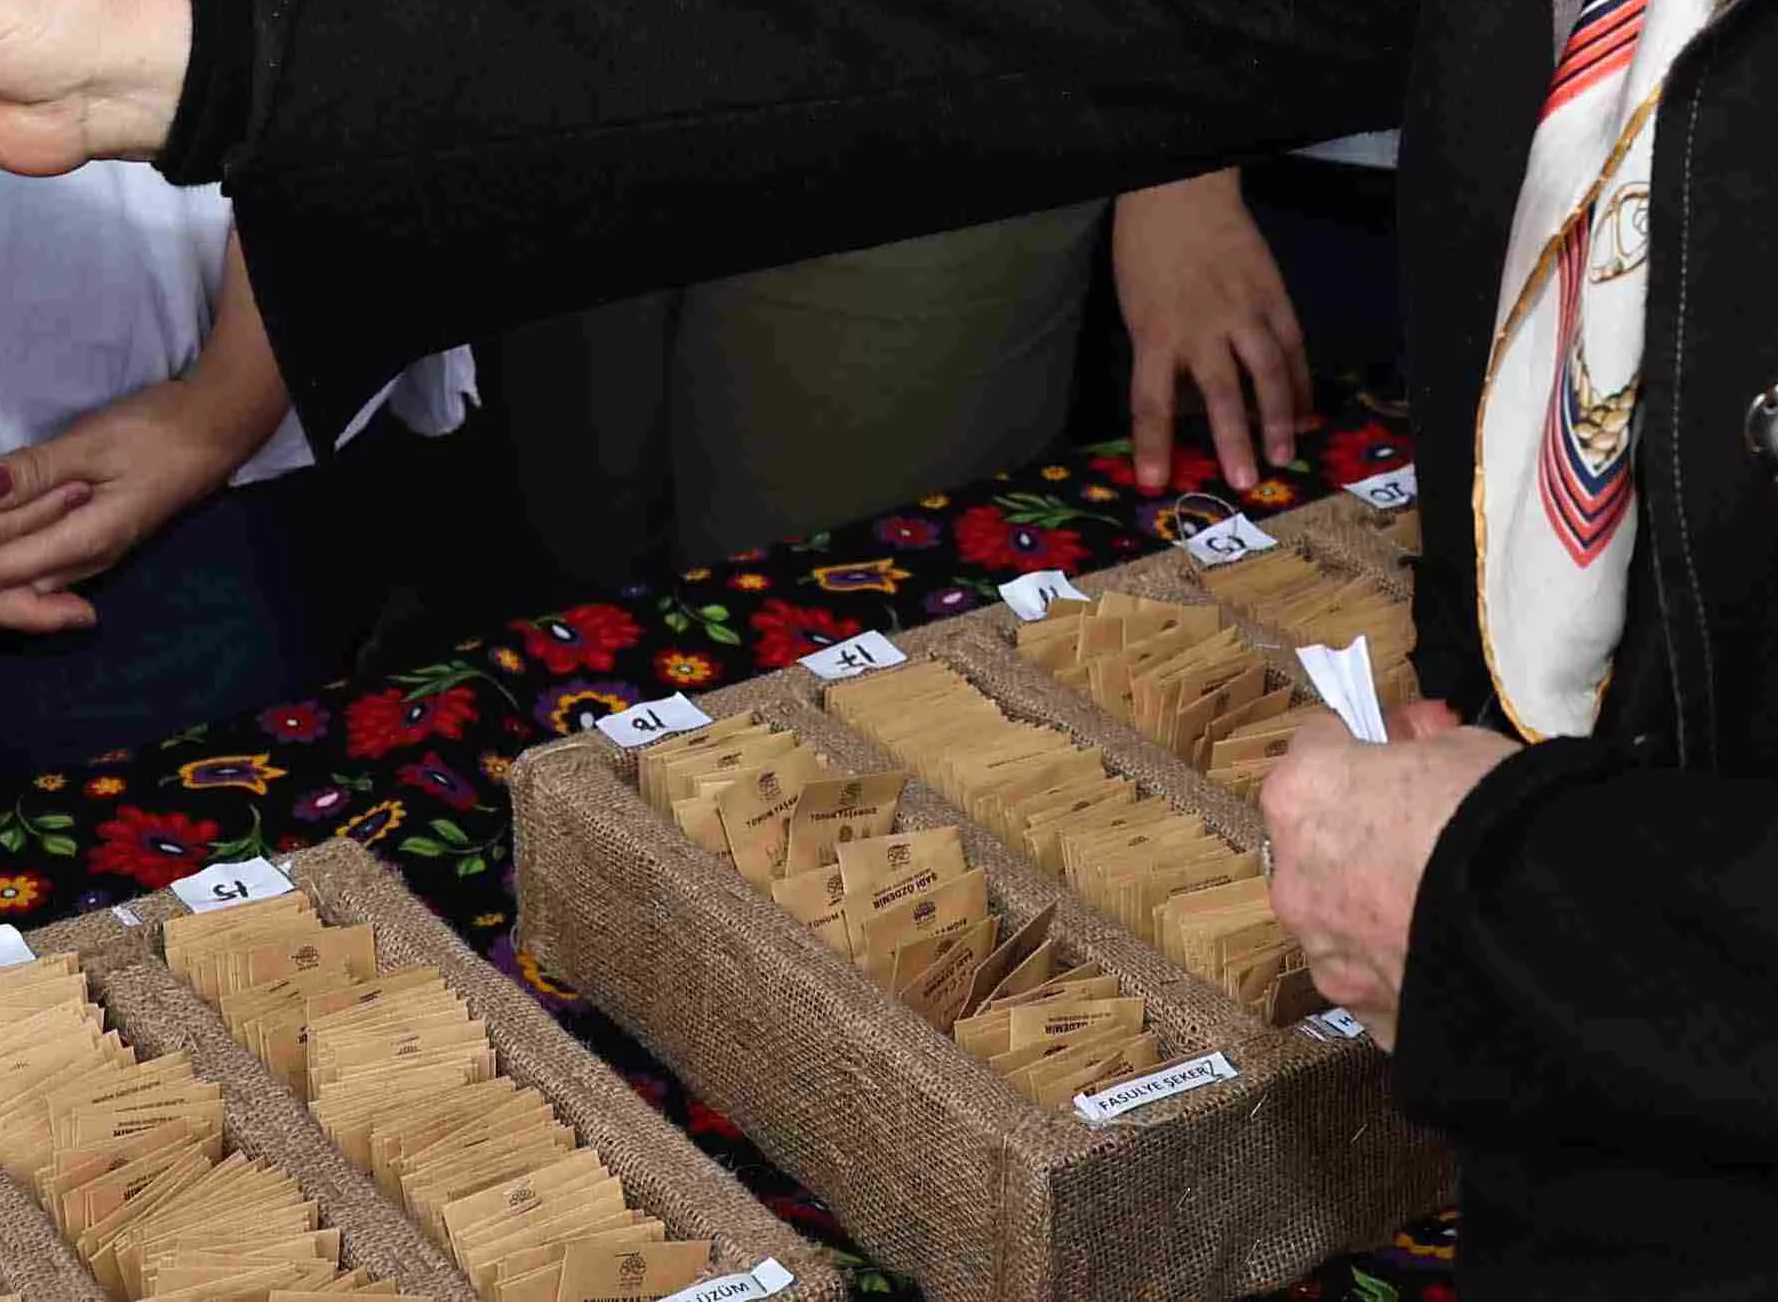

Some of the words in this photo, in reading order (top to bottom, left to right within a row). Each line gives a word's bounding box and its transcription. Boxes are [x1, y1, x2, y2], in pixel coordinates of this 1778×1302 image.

[836, 644, 876, 672] 17
[213, 881, 249, 902] 15
[1098, 1080, 1163, 1111] FASULYE
[1163, 1066, 1207, 1089] ŞEKER
